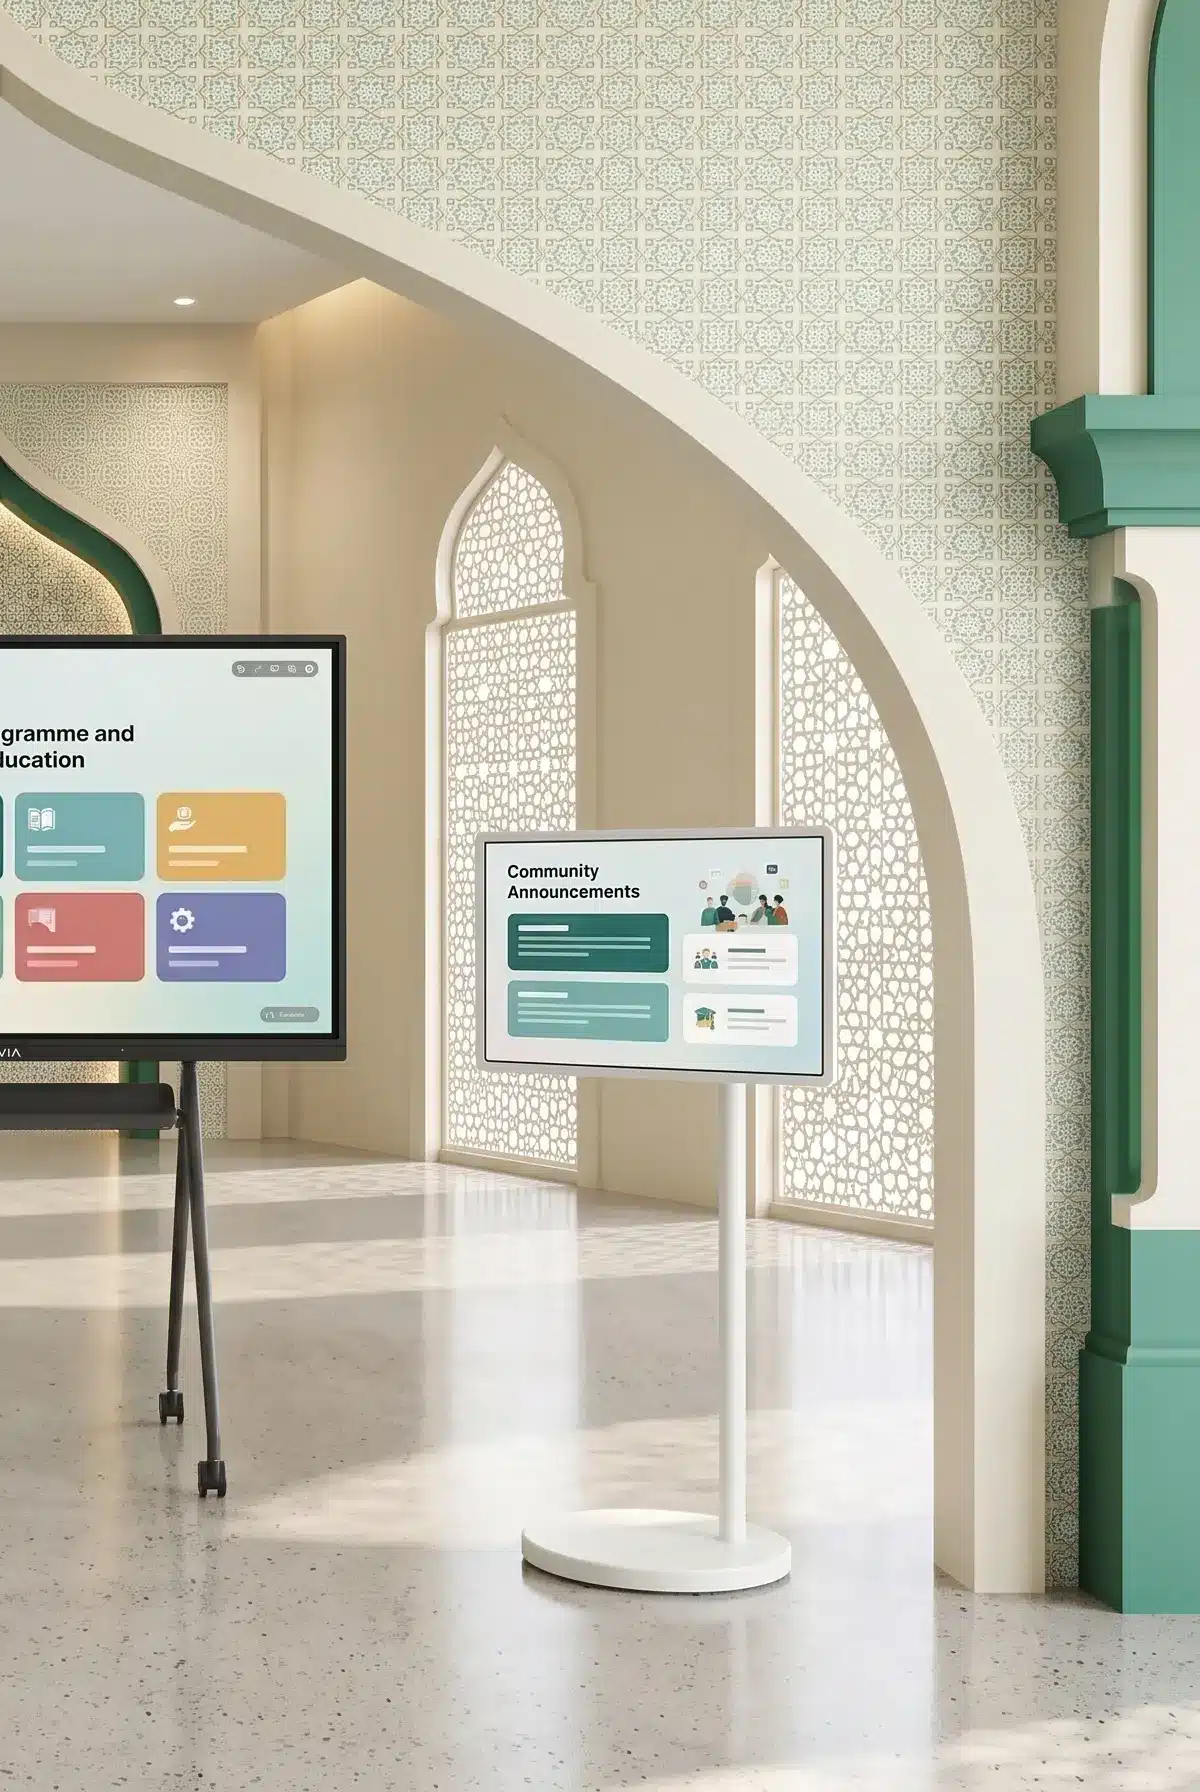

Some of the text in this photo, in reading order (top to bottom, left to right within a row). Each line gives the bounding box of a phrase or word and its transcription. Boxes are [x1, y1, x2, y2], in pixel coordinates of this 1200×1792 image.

[95, 724, 135, 743] and
[507, 863, 600, 882] Community
[507, 884, 641, 899] Announcements
